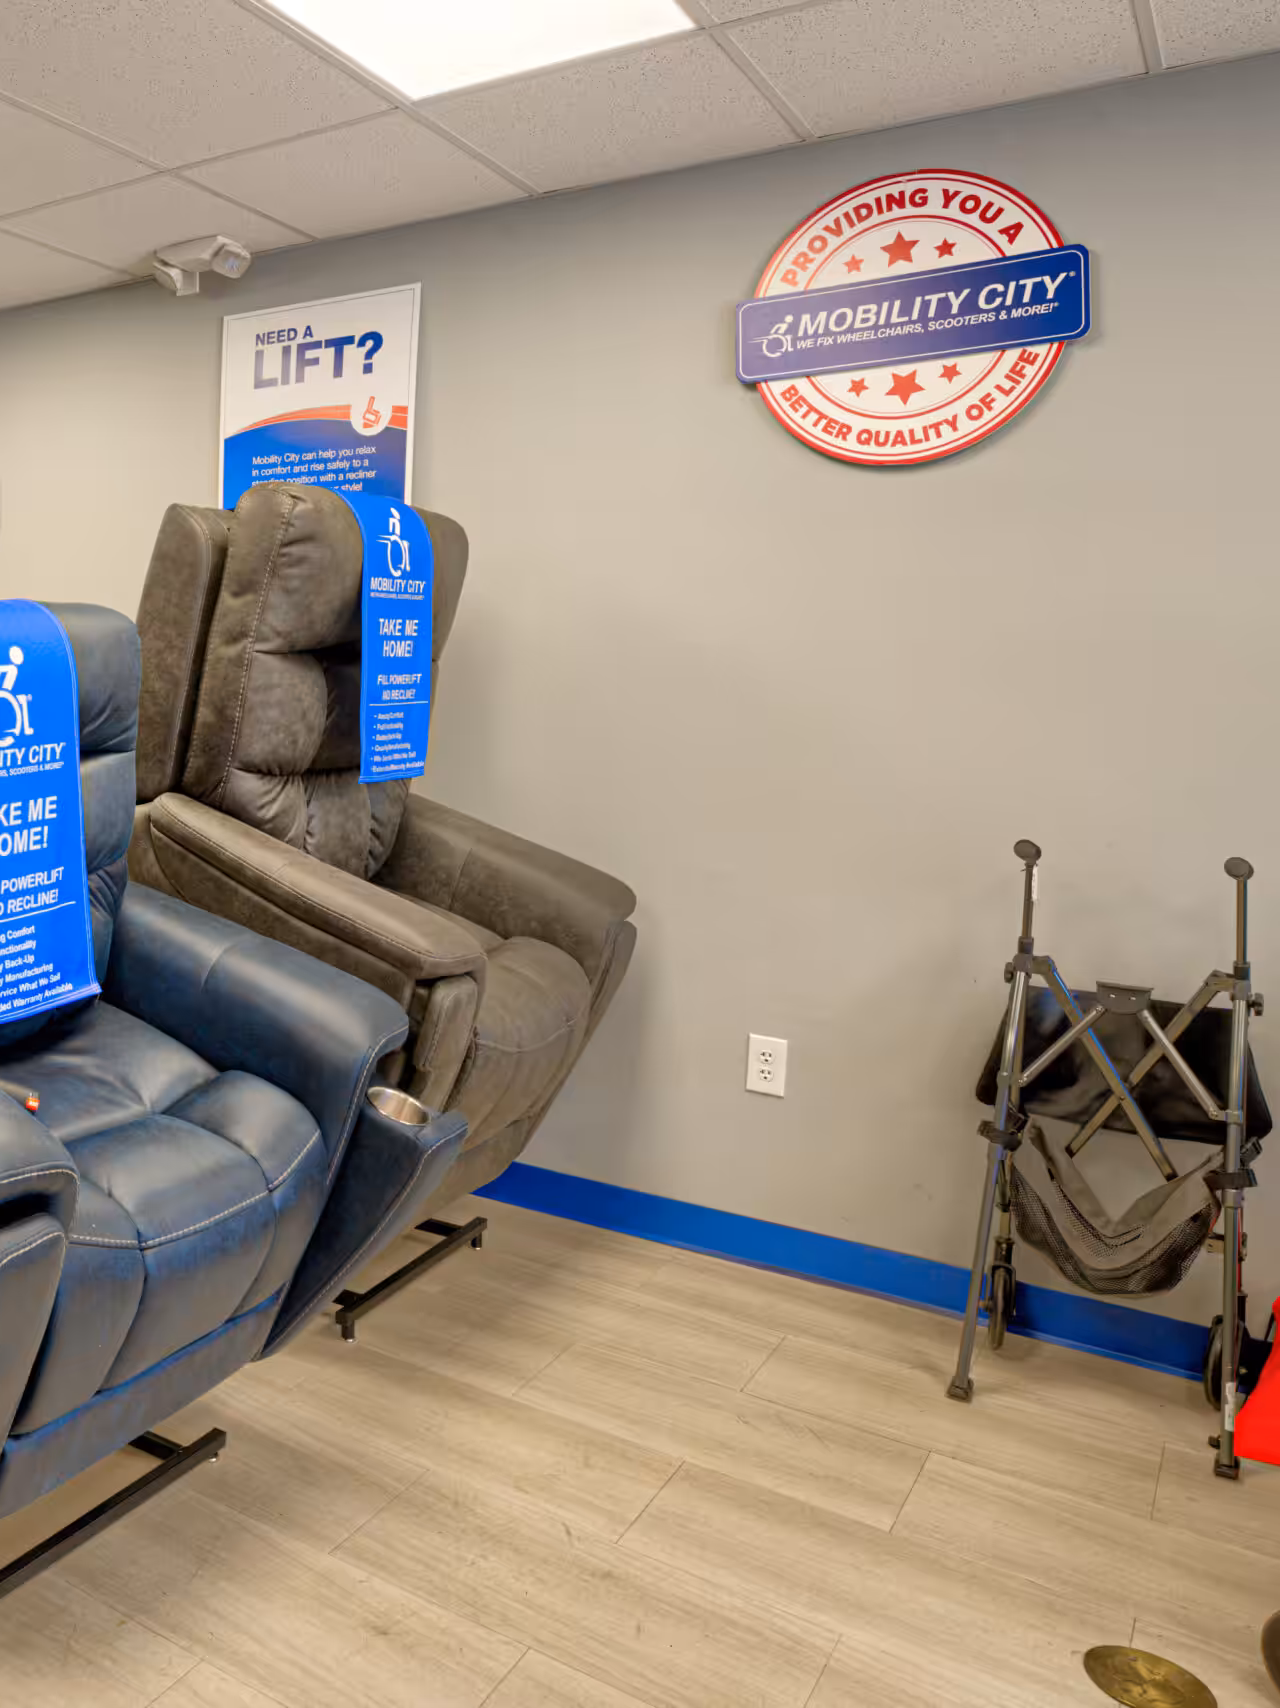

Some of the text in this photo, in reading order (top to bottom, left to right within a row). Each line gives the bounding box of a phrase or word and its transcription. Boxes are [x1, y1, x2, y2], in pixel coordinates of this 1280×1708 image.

[780, 188, 1024, 287] PROVIDING YOU A
[798, 271, 1068, 337] MOBILITY CITY
[255, 325, 314, 346] NEED A
[796, 302, 1054, 350] WE FIX WHEELCHAIRS, SCOOTERS & MORE!
[253, 331, 384, 390] LIFT?
[780, 348, 1040, 447] BETTER QUALITY OF LIFE
[252, 445, 376, 465] Mobility City can help you relax
[252, 458, 369, 476] in comfort and rise safely to a
[320, 472, 336, 482] with
[346, 469, 376, 480] recliner
[370, 576, 425, 593] MOBILITY CITY
[379, 618, 419, 636] TAKE ME
[383, 640, 414, 657] HOME!
[28, 742, 65, 764] CITY
[28, 795, 58, 822] ME
[1, 866, 64, 895] POWERLIFT
[7, 888, 59, 914] RECLINE!
[7, 925, 35, 940] Comfort
[5, 954, 35, 969] Back-Up
[5, 963, 53, 983] Manufacturing
[19, 981, 38, 992] What
[39, 977, 48, 987] We
[49, 972, 61, 983] Sell
[13, 993, 43, 1008] Warranty
[44, 982, 73, 998] Available
